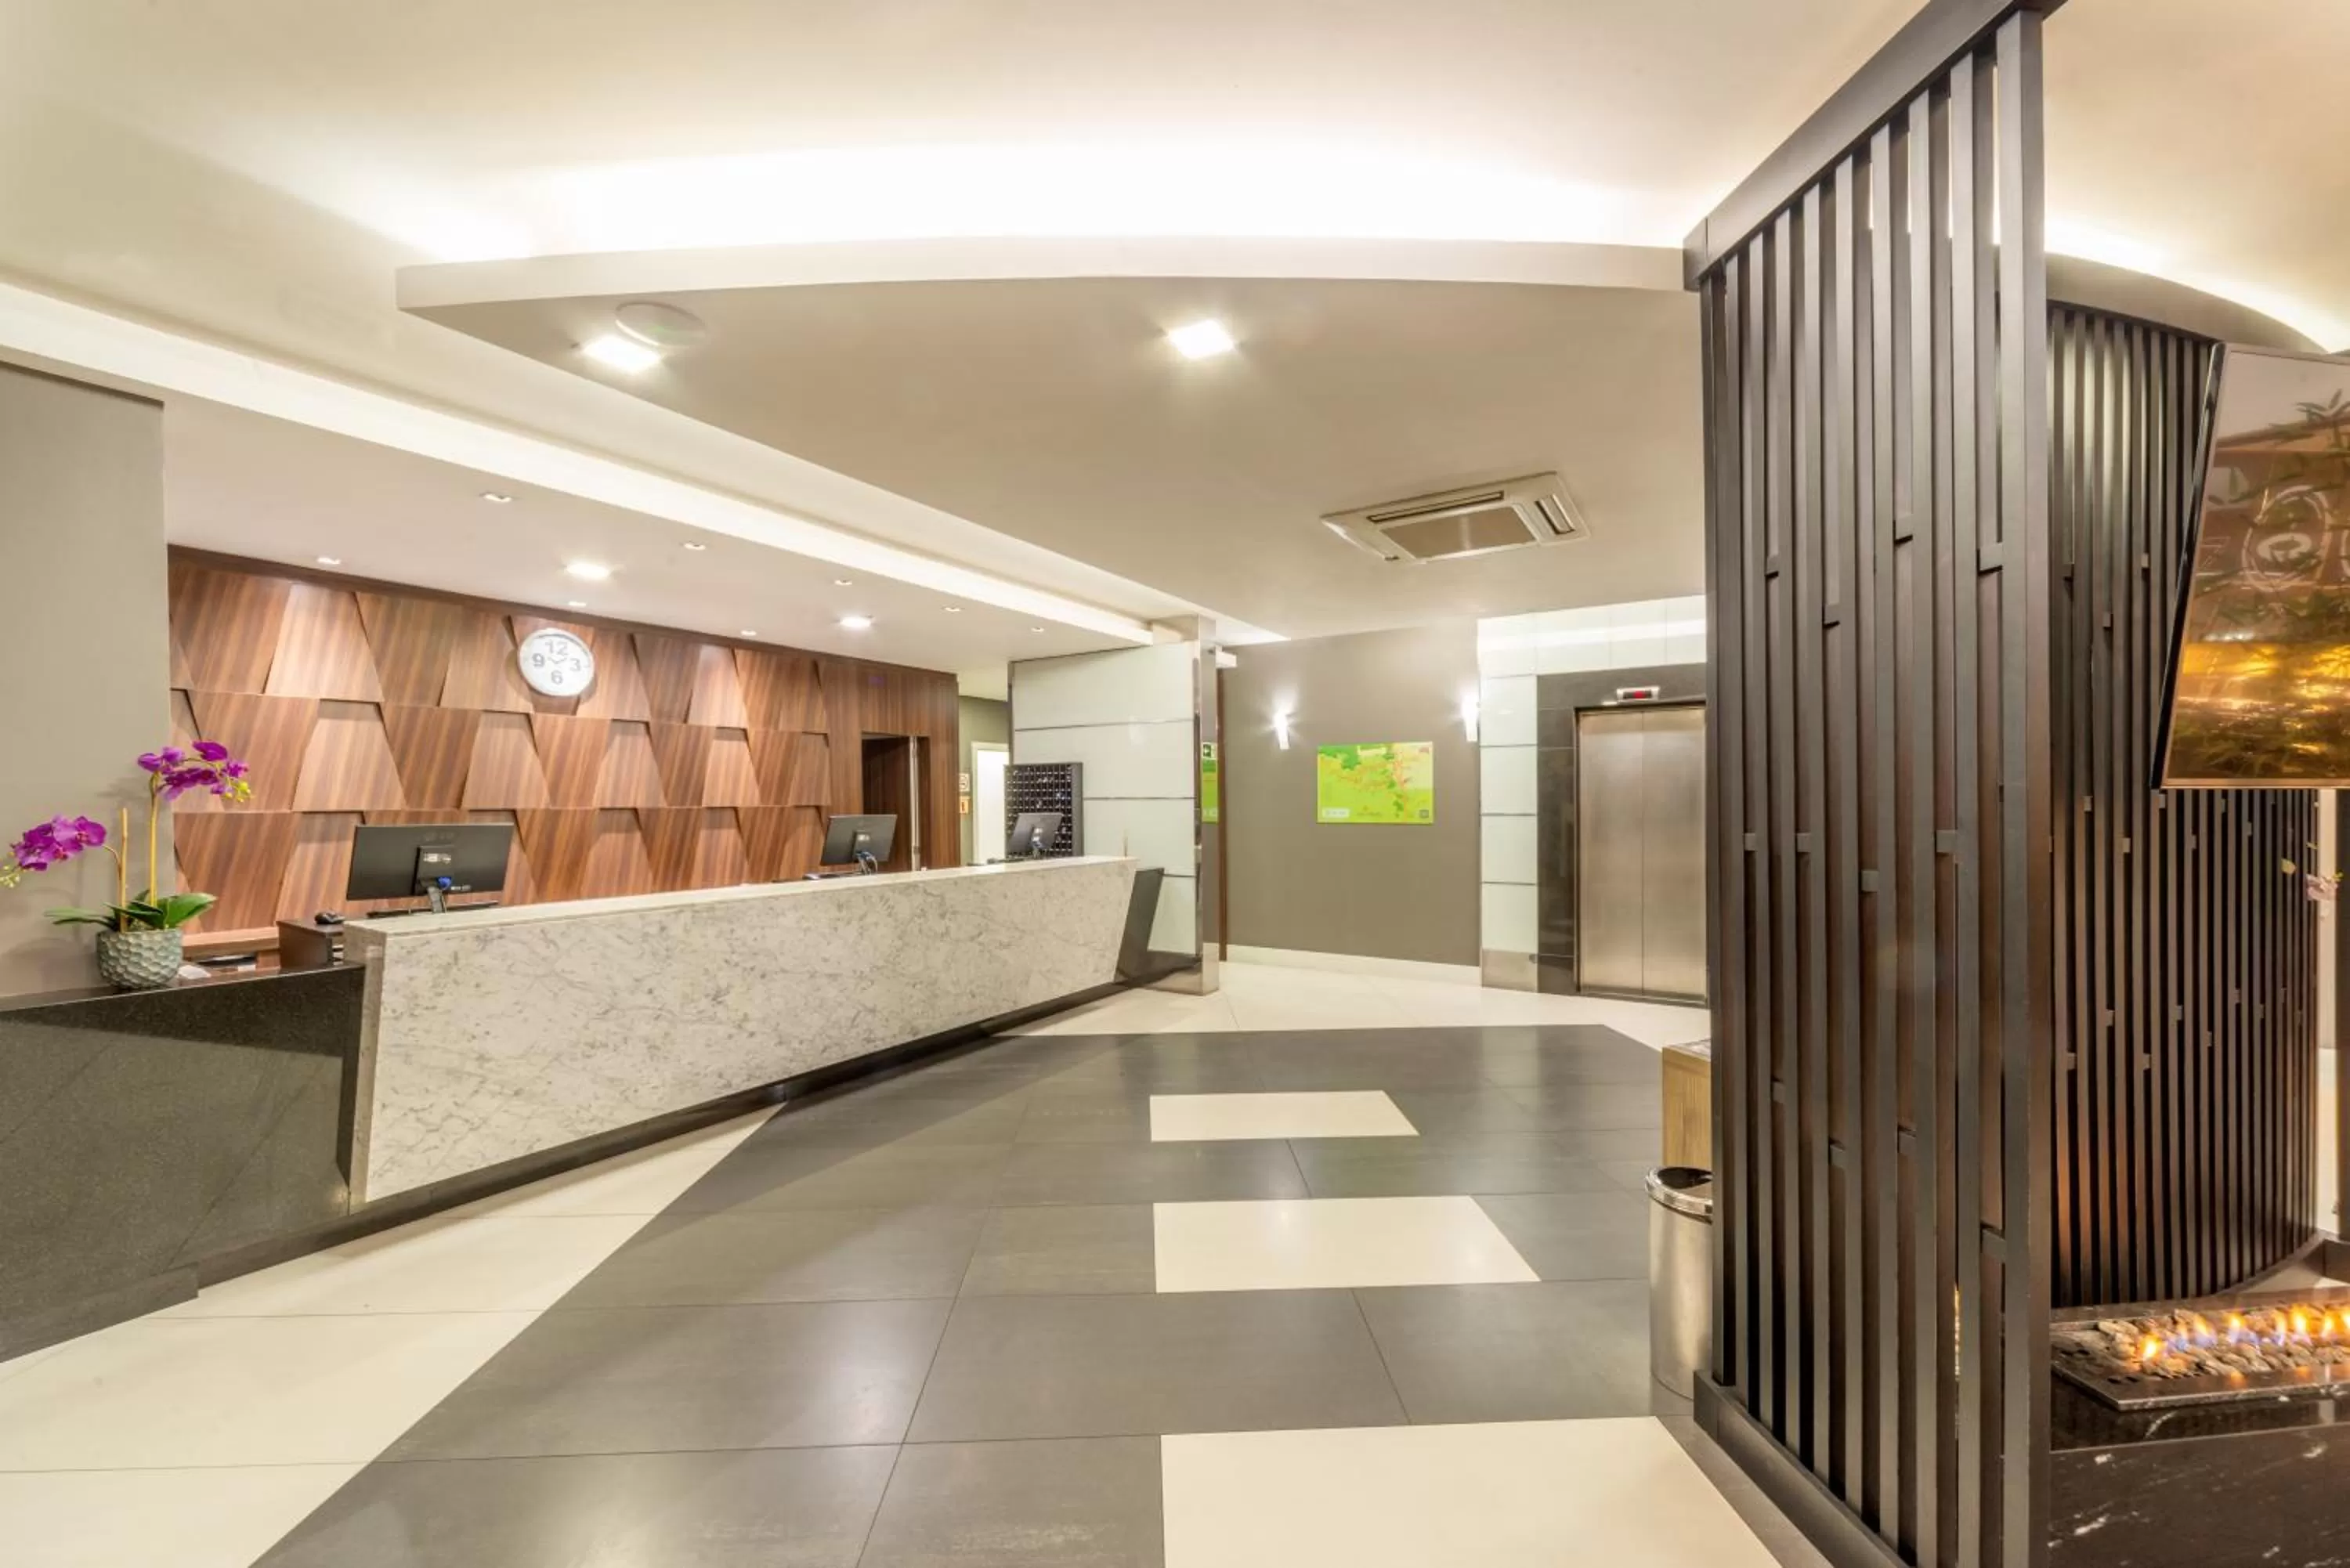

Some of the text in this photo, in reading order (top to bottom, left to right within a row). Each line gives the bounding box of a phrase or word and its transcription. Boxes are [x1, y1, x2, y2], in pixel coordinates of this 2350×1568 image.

[545, 640, 568, 656] 12
[532, 653, 545, 667] 9
[569, 658, 580, 671] 3
[551, 670, 563, 685] 6
